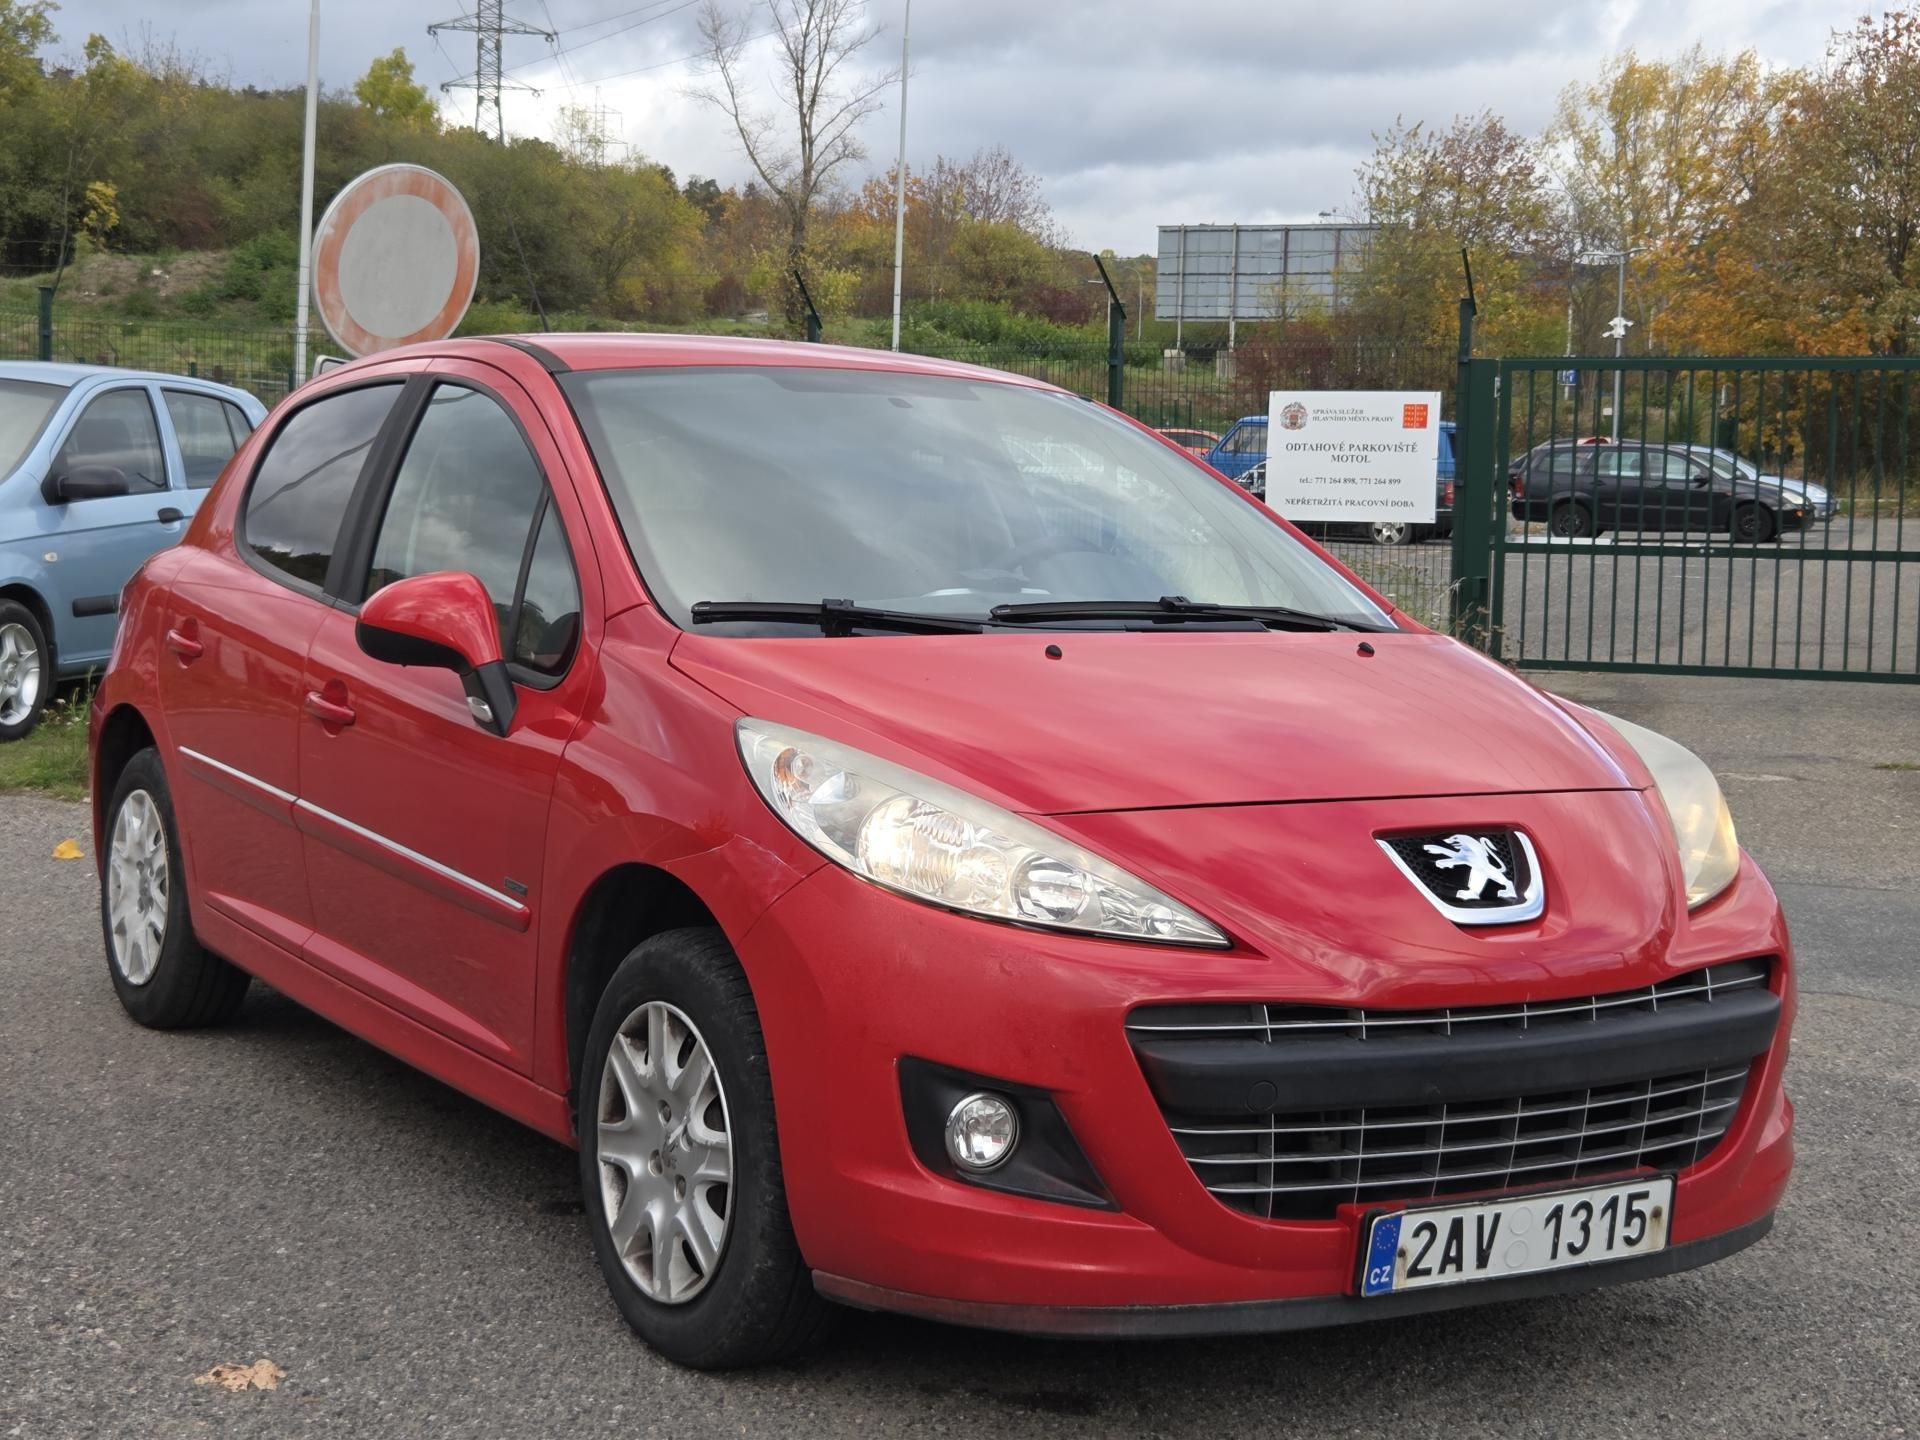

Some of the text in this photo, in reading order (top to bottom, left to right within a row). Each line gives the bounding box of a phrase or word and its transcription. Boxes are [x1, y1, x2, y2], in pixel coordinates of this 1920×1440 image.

[1285, 442, 1418, 453] ODTAHOVÉ PARKOVIŠTĚ
[1331, 454, 1371, 463] MOTOL
[1343, 477, 1358, 485] 898,
[1285, 497, 1415, 508] NEPŘETRŽITÁ PRACOVNÍ DOBA
[1406, 1190, 1650, 1279] 2AV 1315
[1370, 1264, 1390, 1286] CZ
